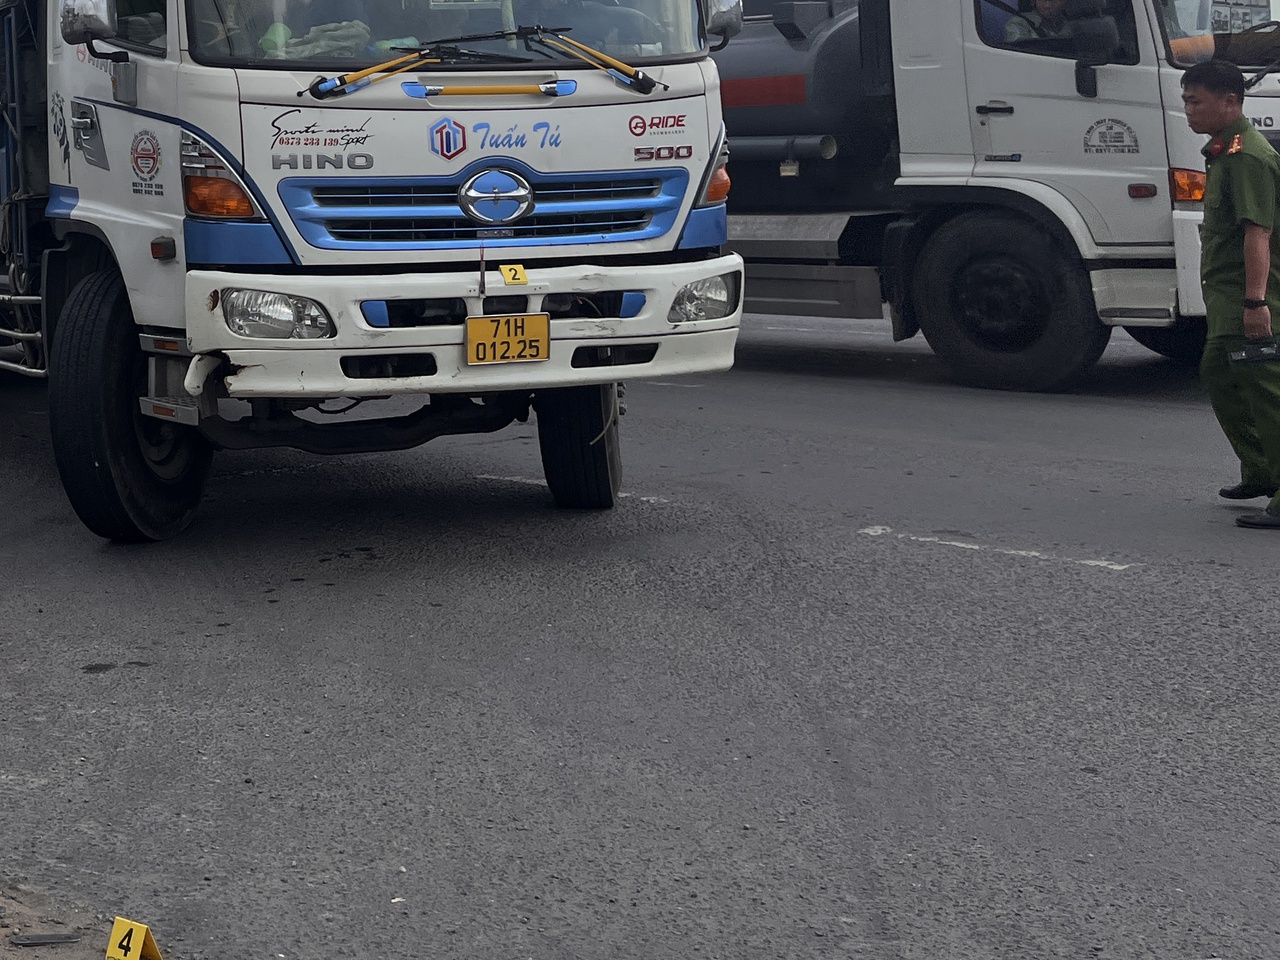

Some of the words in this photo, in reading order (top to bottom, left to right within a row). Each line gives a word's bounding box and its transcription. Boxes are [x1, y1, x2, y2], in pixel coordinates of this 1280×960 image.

[648, 115, 687, 129] RIDE
[1246, 116, 1275, 128] NO
[278, 136, 301, 146] 0373
[303, 137, 320, 147] 233
[323, 137, 339, 147] 139
[472, 122, 528, 150] Tuấn
[533, 121, 562, 149] Tú
[271, 153, 374, 170] HINO
[634, 145, 693, 162] 500
[508, 267, 520, 281] 2
[490, 317, 525, 338] 71H
[475, 339, 540, 361] 012.25
[117, 927, 134, 958] 4
